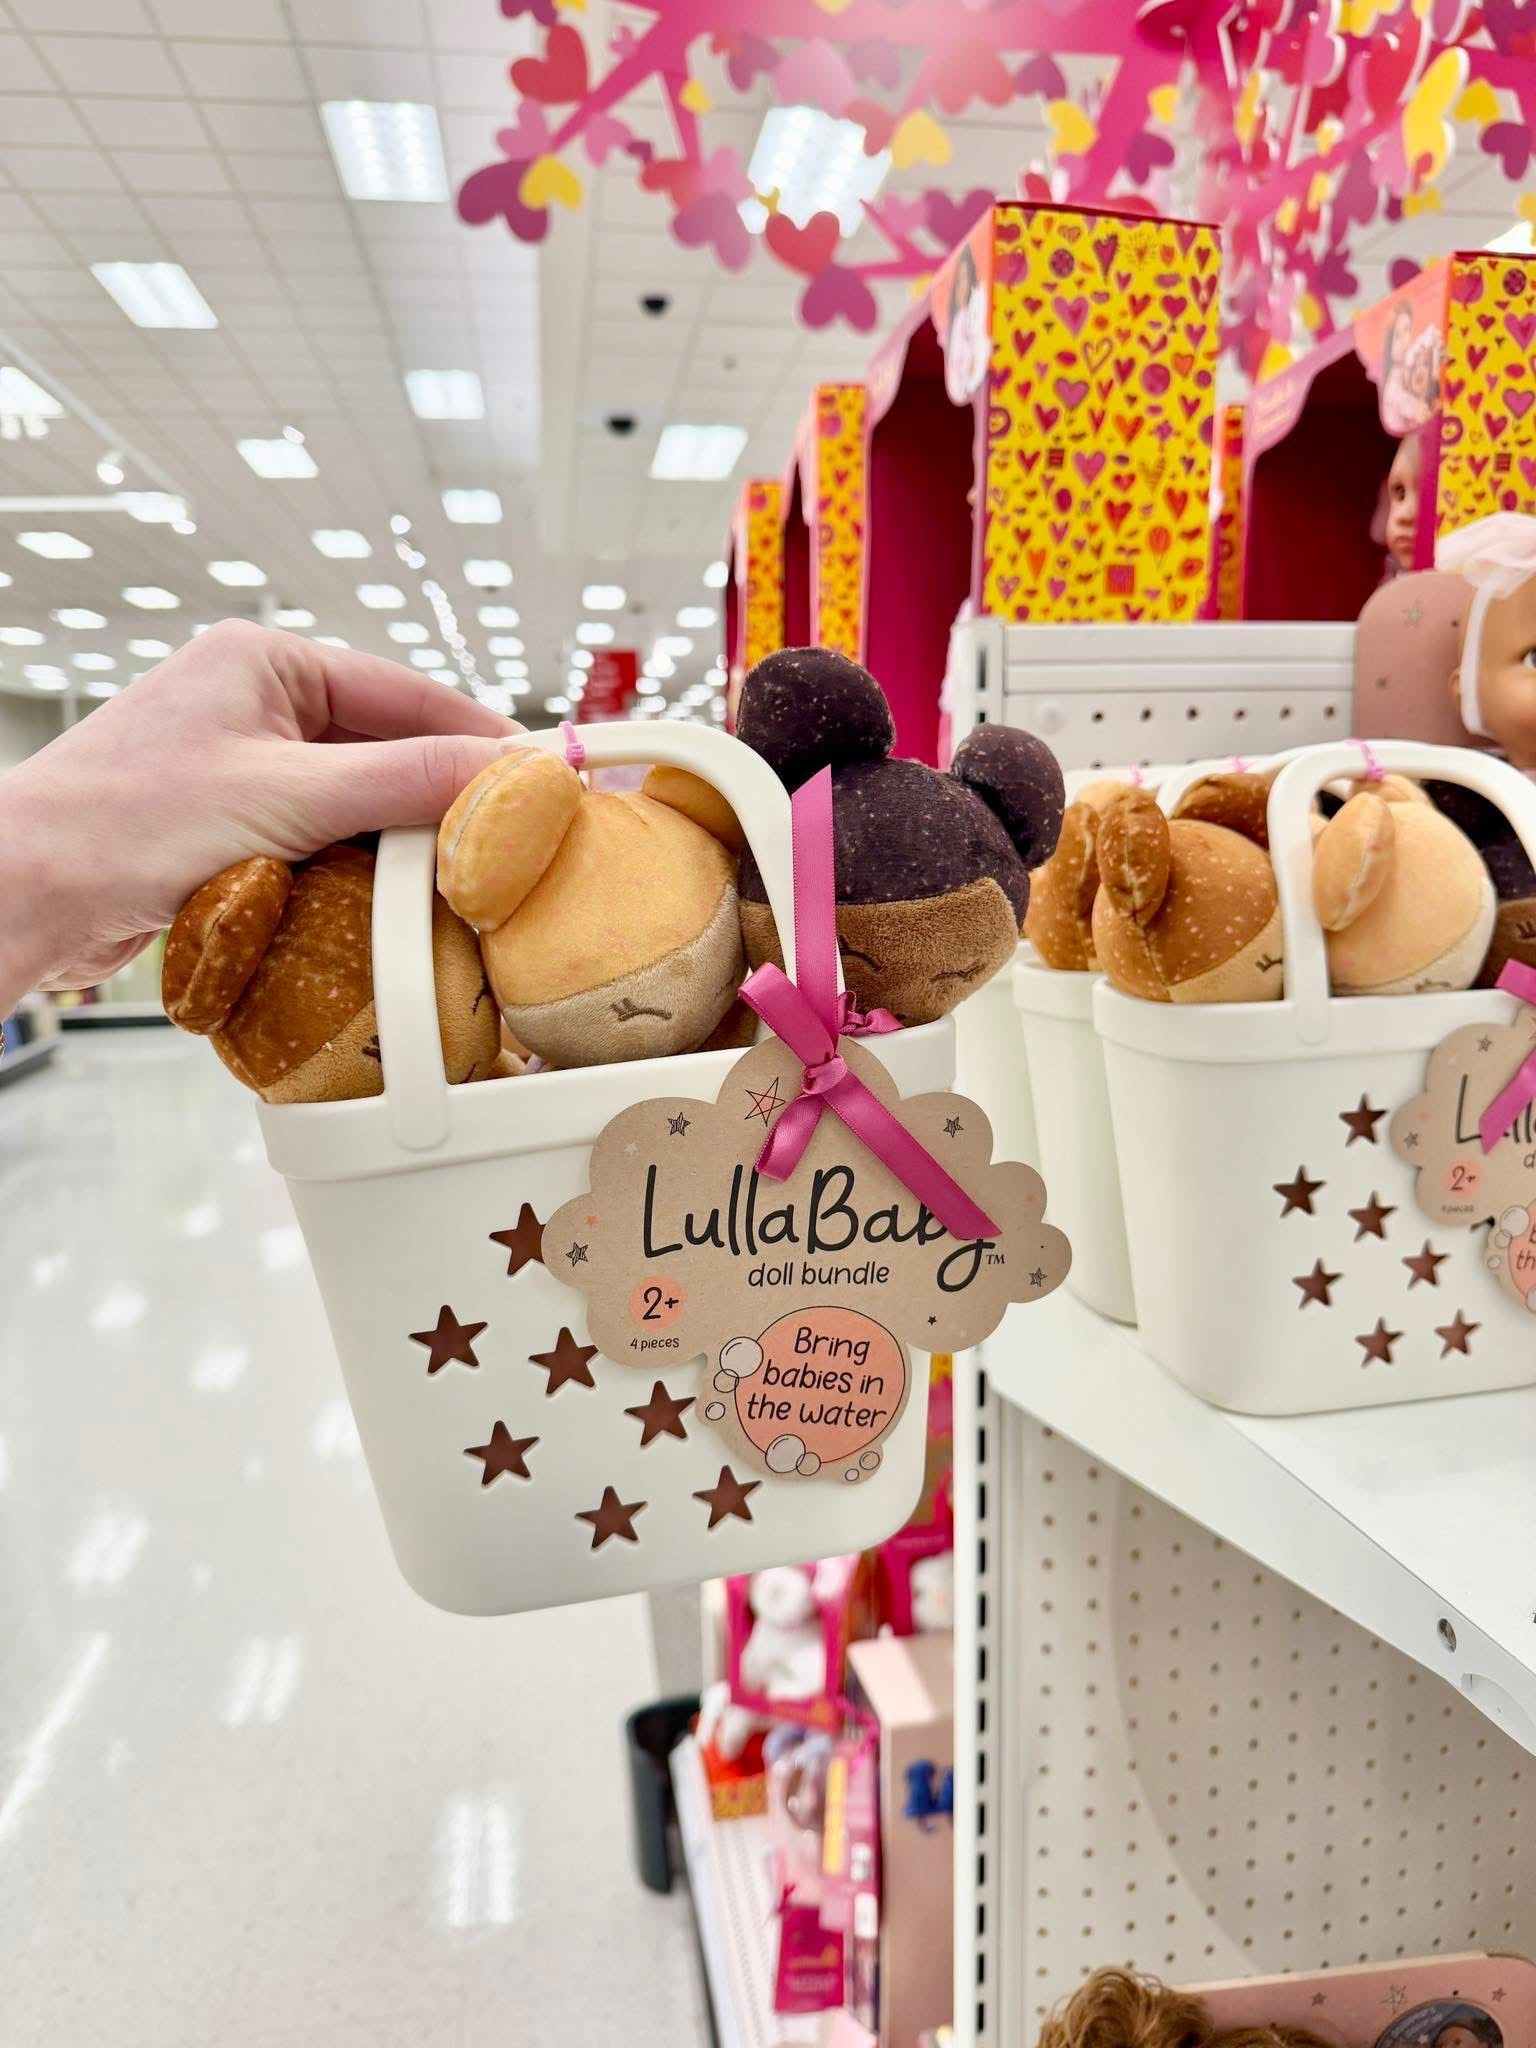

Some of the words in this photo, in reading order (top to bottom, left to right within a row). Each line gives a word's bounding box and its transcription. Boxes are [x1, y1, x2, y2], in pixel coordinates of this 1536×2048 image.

[1450, 1165, 1476, 1191] 2+
[747, 1261, 794, 1287] doll
[801, 1261, 890, 1286] bundle
[1516, 1248, 1536, 1271] th
[642, 1286, 680, 1320] 2+
[630, 1338, 638, 1350] 4
[640, 1337, 680, 1352] pieces
[793, 1326, 871, 1366] Bring
[762, 1358, 854, 1394] babies
[859, 1374, 885, 1396] in
[747, 1392, 792, 1421] the
[799, 1400, 888, 1429] water
